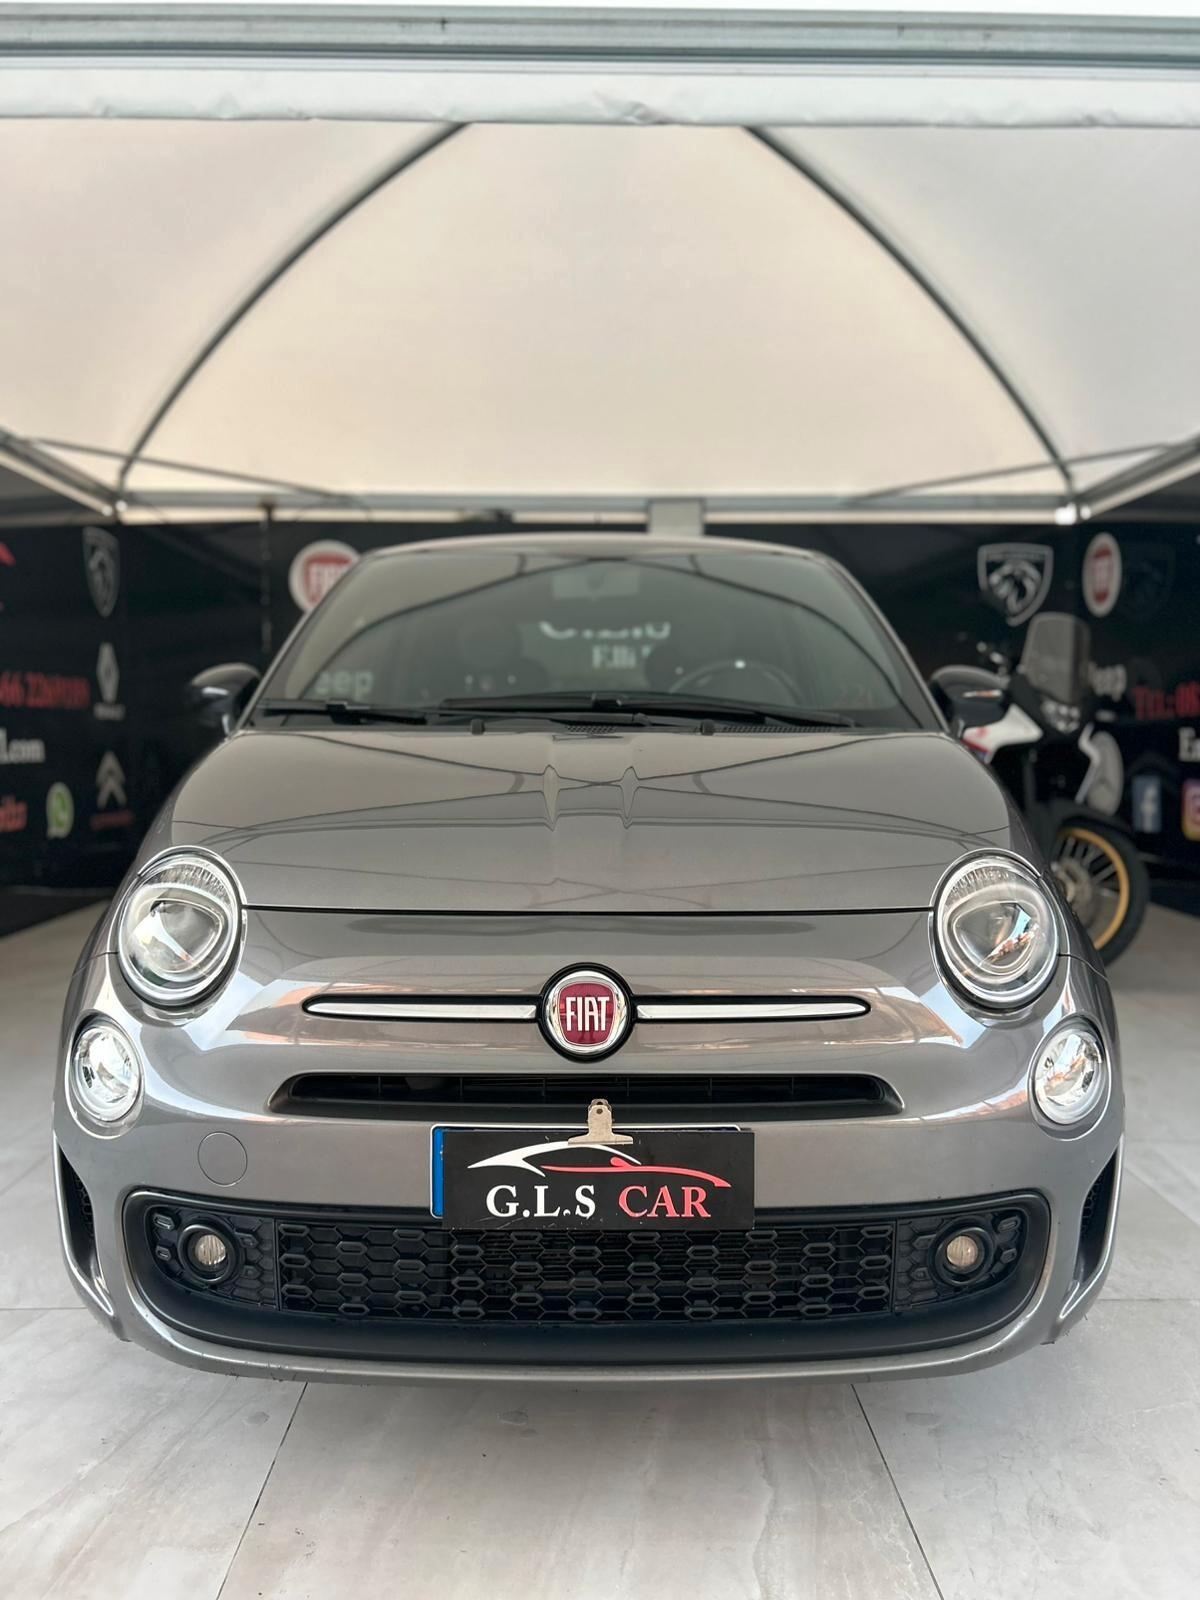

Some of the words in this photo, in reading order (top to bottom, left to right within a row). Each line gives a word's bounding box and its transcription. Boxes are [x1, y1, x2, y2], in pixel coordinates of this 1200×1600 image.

[314, 670, 374, 697] eep
[565, 996, 610, 1031] FIAT
[486, 1184, 596, 1219] G.L.S
[618, 1185, 712, 1218] CAR
